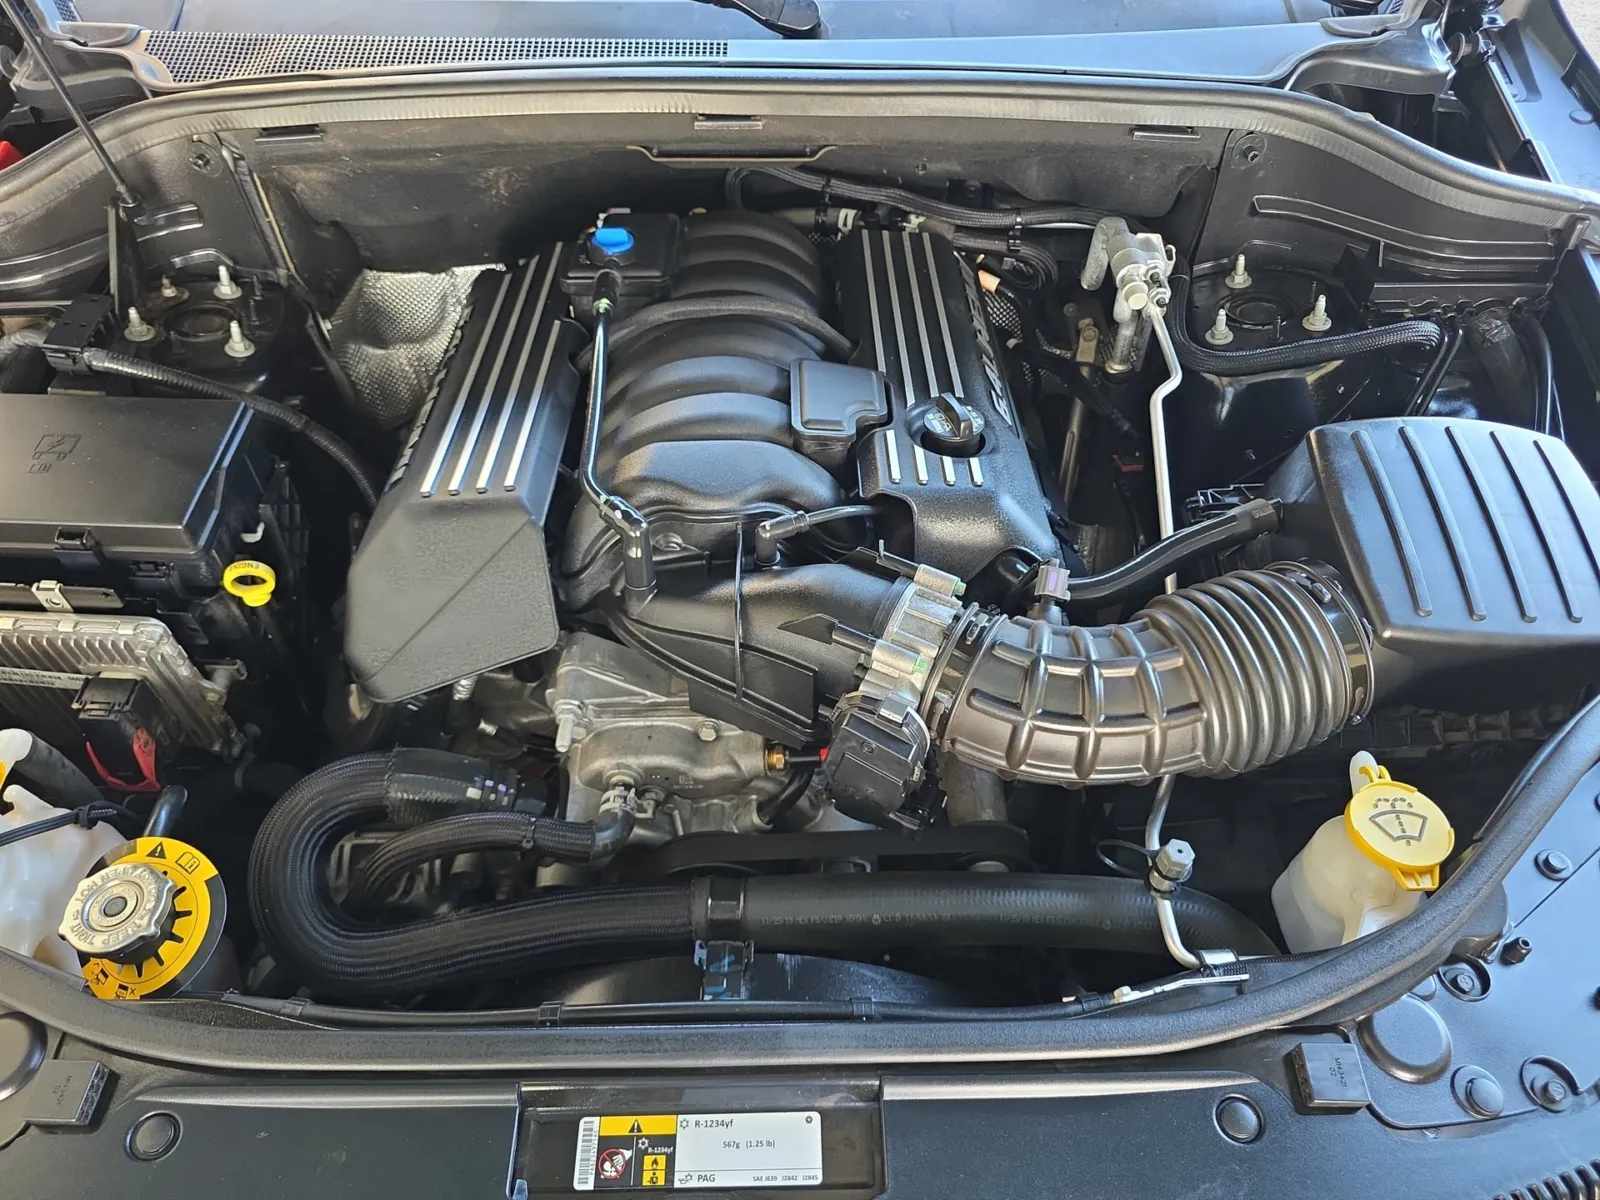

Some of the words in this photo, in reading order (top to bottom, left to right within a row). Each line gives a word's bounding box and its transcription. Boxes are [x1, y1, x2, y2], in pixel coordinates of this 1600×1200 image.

[69, 921, 97, 946] TIGHT
[101, 920, 142, 945] KEEP
[694, 1118, 734, 1129] R-1234yf
[722, 1140, 741, 1149] 567g
[745, 1139, 764, 1149] (1.25
[765, 1139, 776, 1148] lb)
[648, 1146, 674, 1155] R-1234yf
[697, 1173, 716, 1183] PAG
